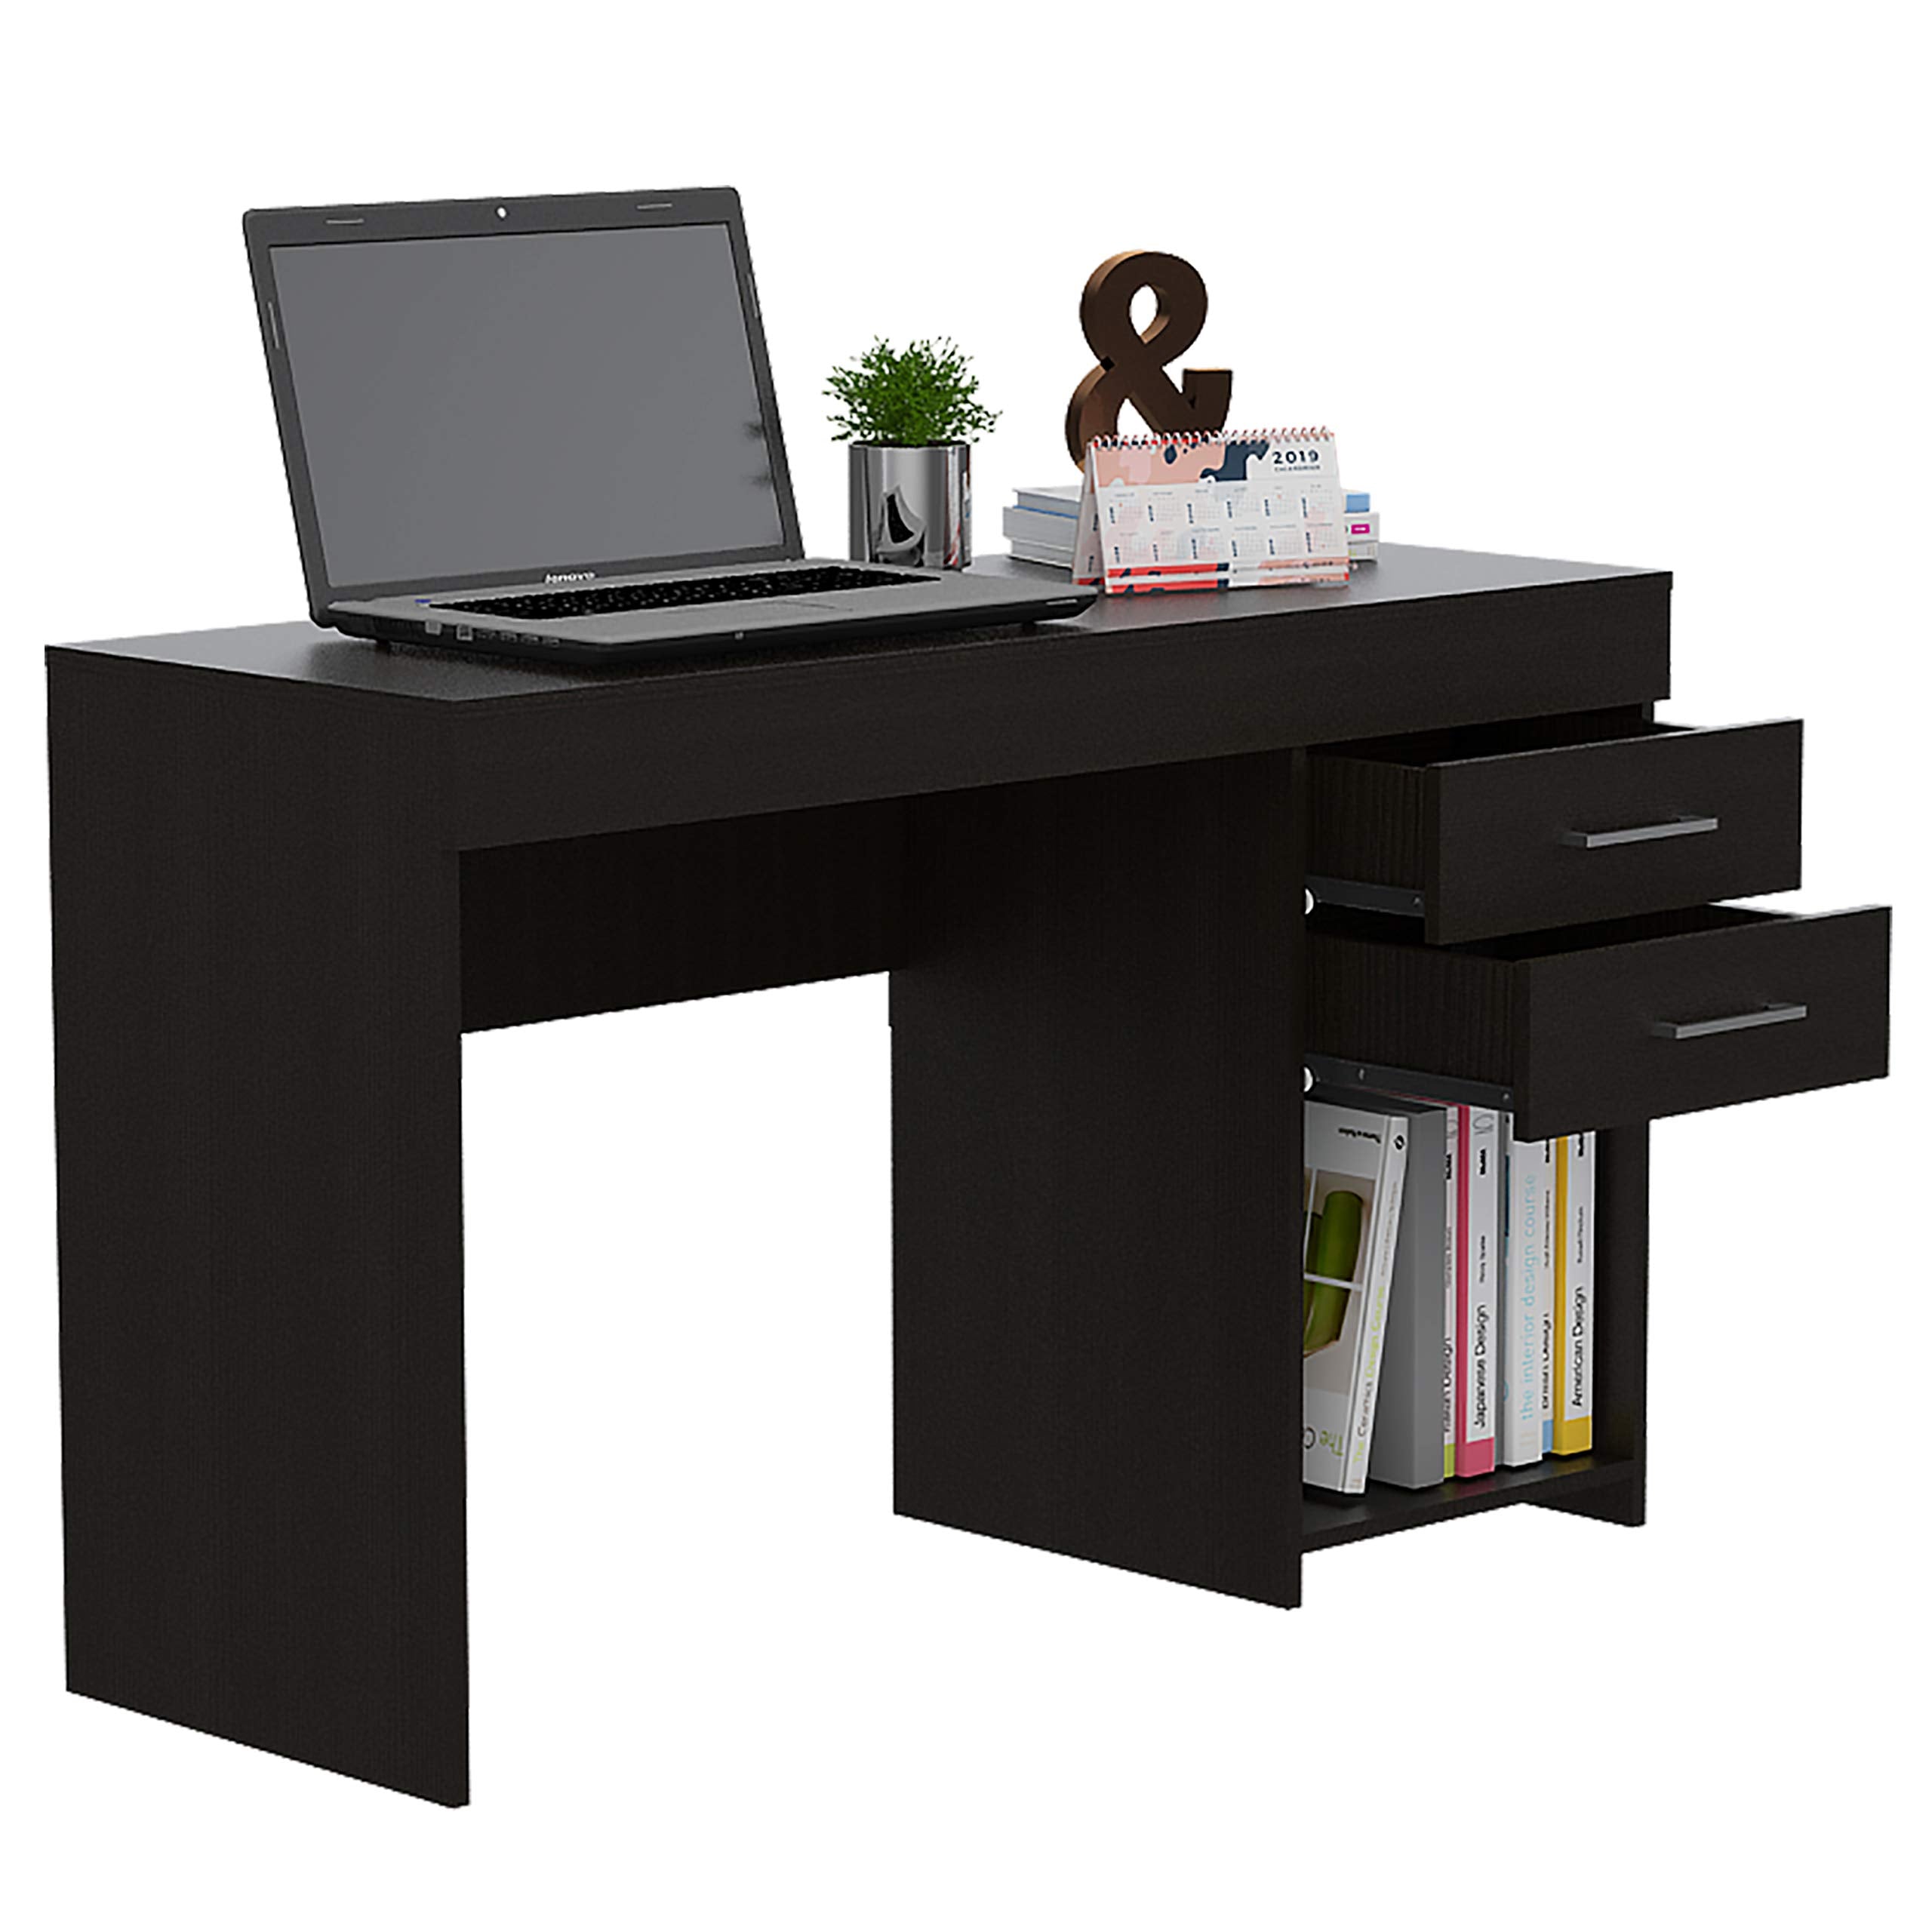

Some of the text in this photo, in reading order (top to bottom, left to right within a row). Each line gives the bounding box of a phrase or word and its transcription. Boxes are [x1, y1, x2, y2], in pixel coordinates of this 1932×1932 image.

[1272, 449, 1319, 464] 2019
[1521, 1174, 1538, 1421] the interior design course
[1571, 1285, 1586, 1408] American Design
[1473, 1304, 1491, 1429] Japanese Design
